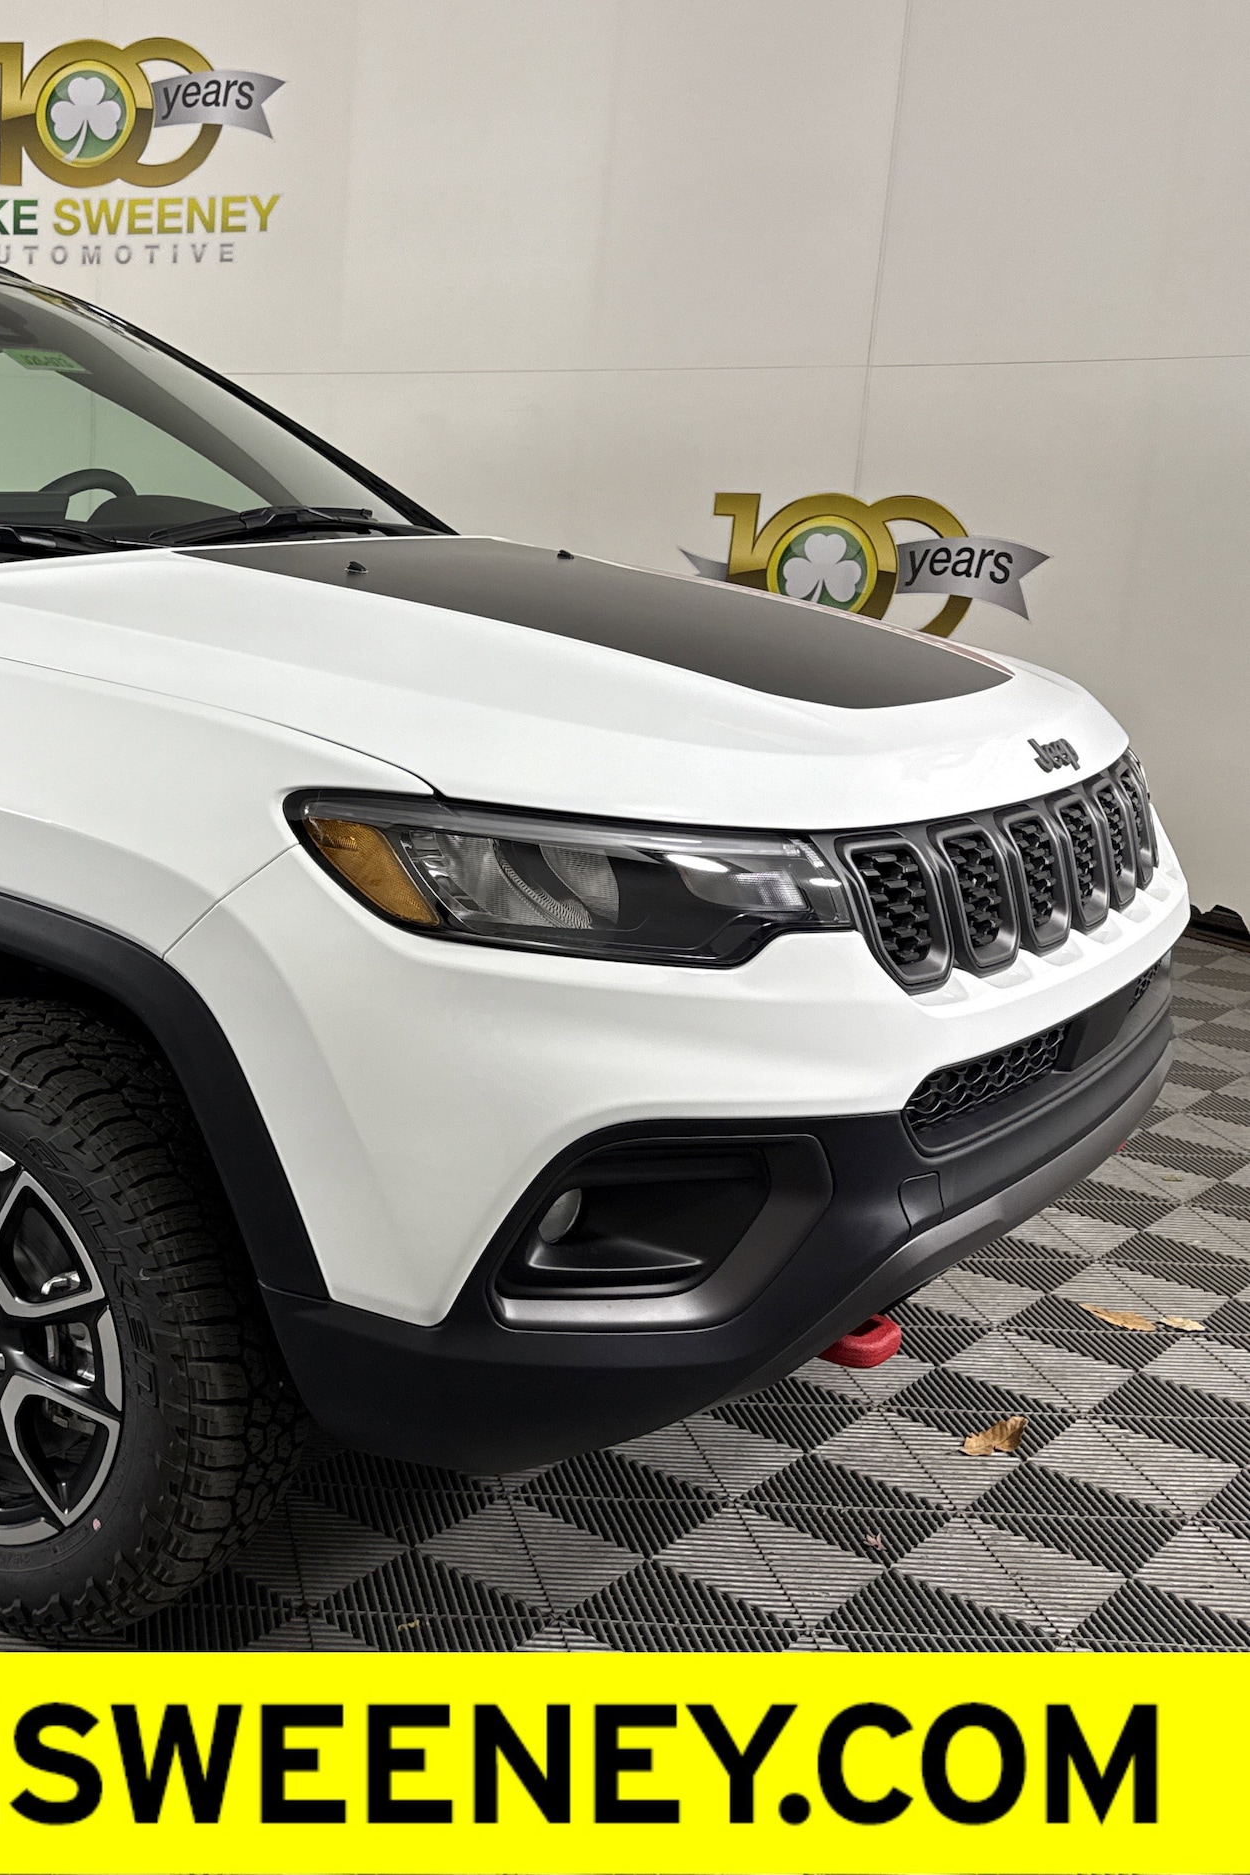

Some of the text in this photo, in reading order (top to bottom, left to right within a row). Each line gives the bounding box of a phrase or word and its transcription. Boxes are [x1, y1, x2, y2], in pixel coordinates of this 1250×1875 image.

[161, 78, 255, 120] years
[53, 194, 280, 236] SWEENEY
[904, 546, 1014, 587] years
[1027, 738, 1081, 773] Jeep
